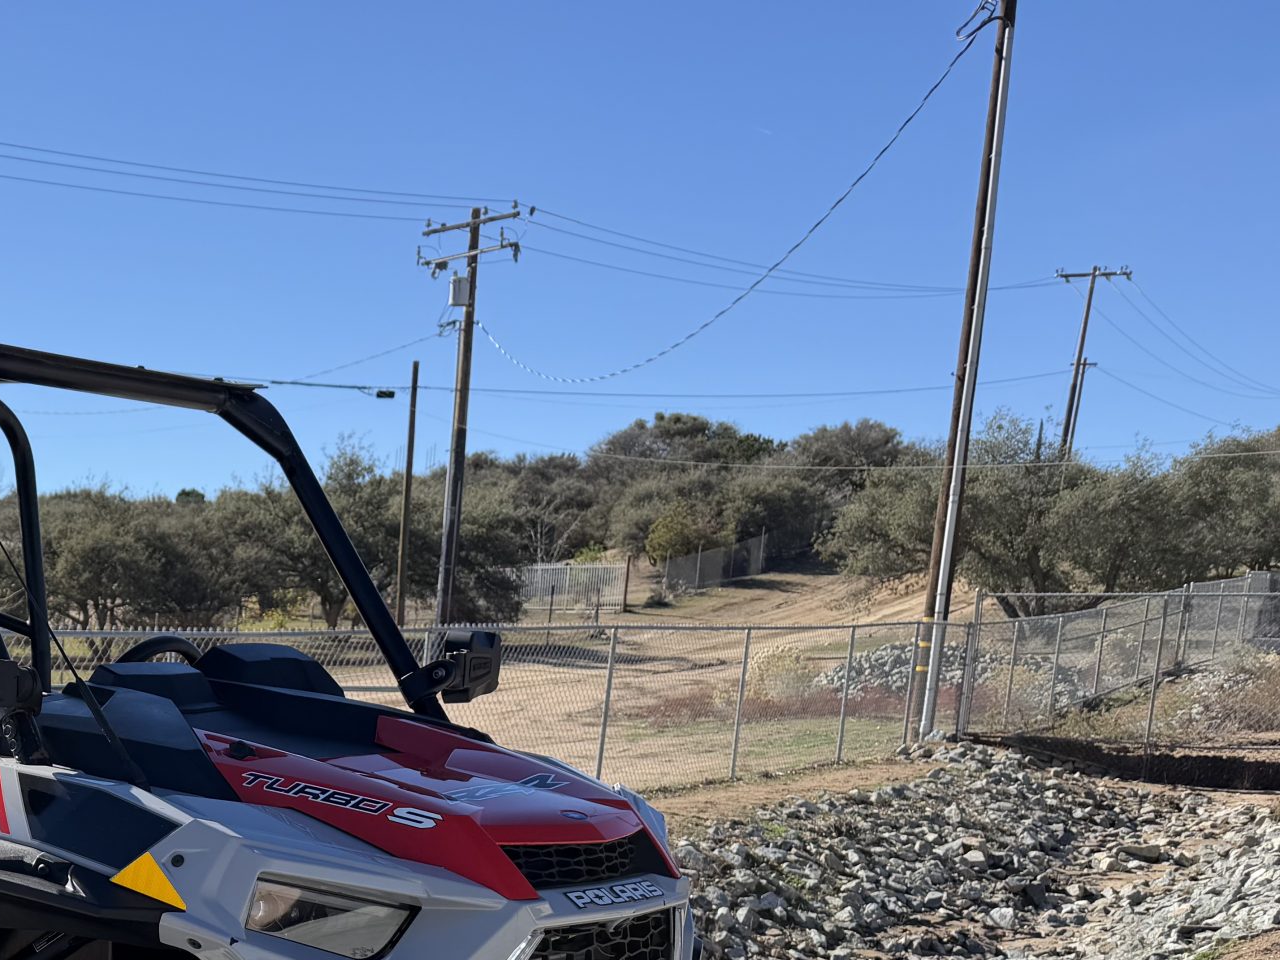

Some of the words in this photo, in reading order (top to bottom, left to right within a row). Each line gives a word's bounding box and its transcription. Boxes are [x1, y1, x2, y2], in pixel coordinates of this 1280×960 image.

[241, 771, 394, 816] TURBO
[386, 806, 444, 829] S
[564, 880, 665, 910] POLARIS
